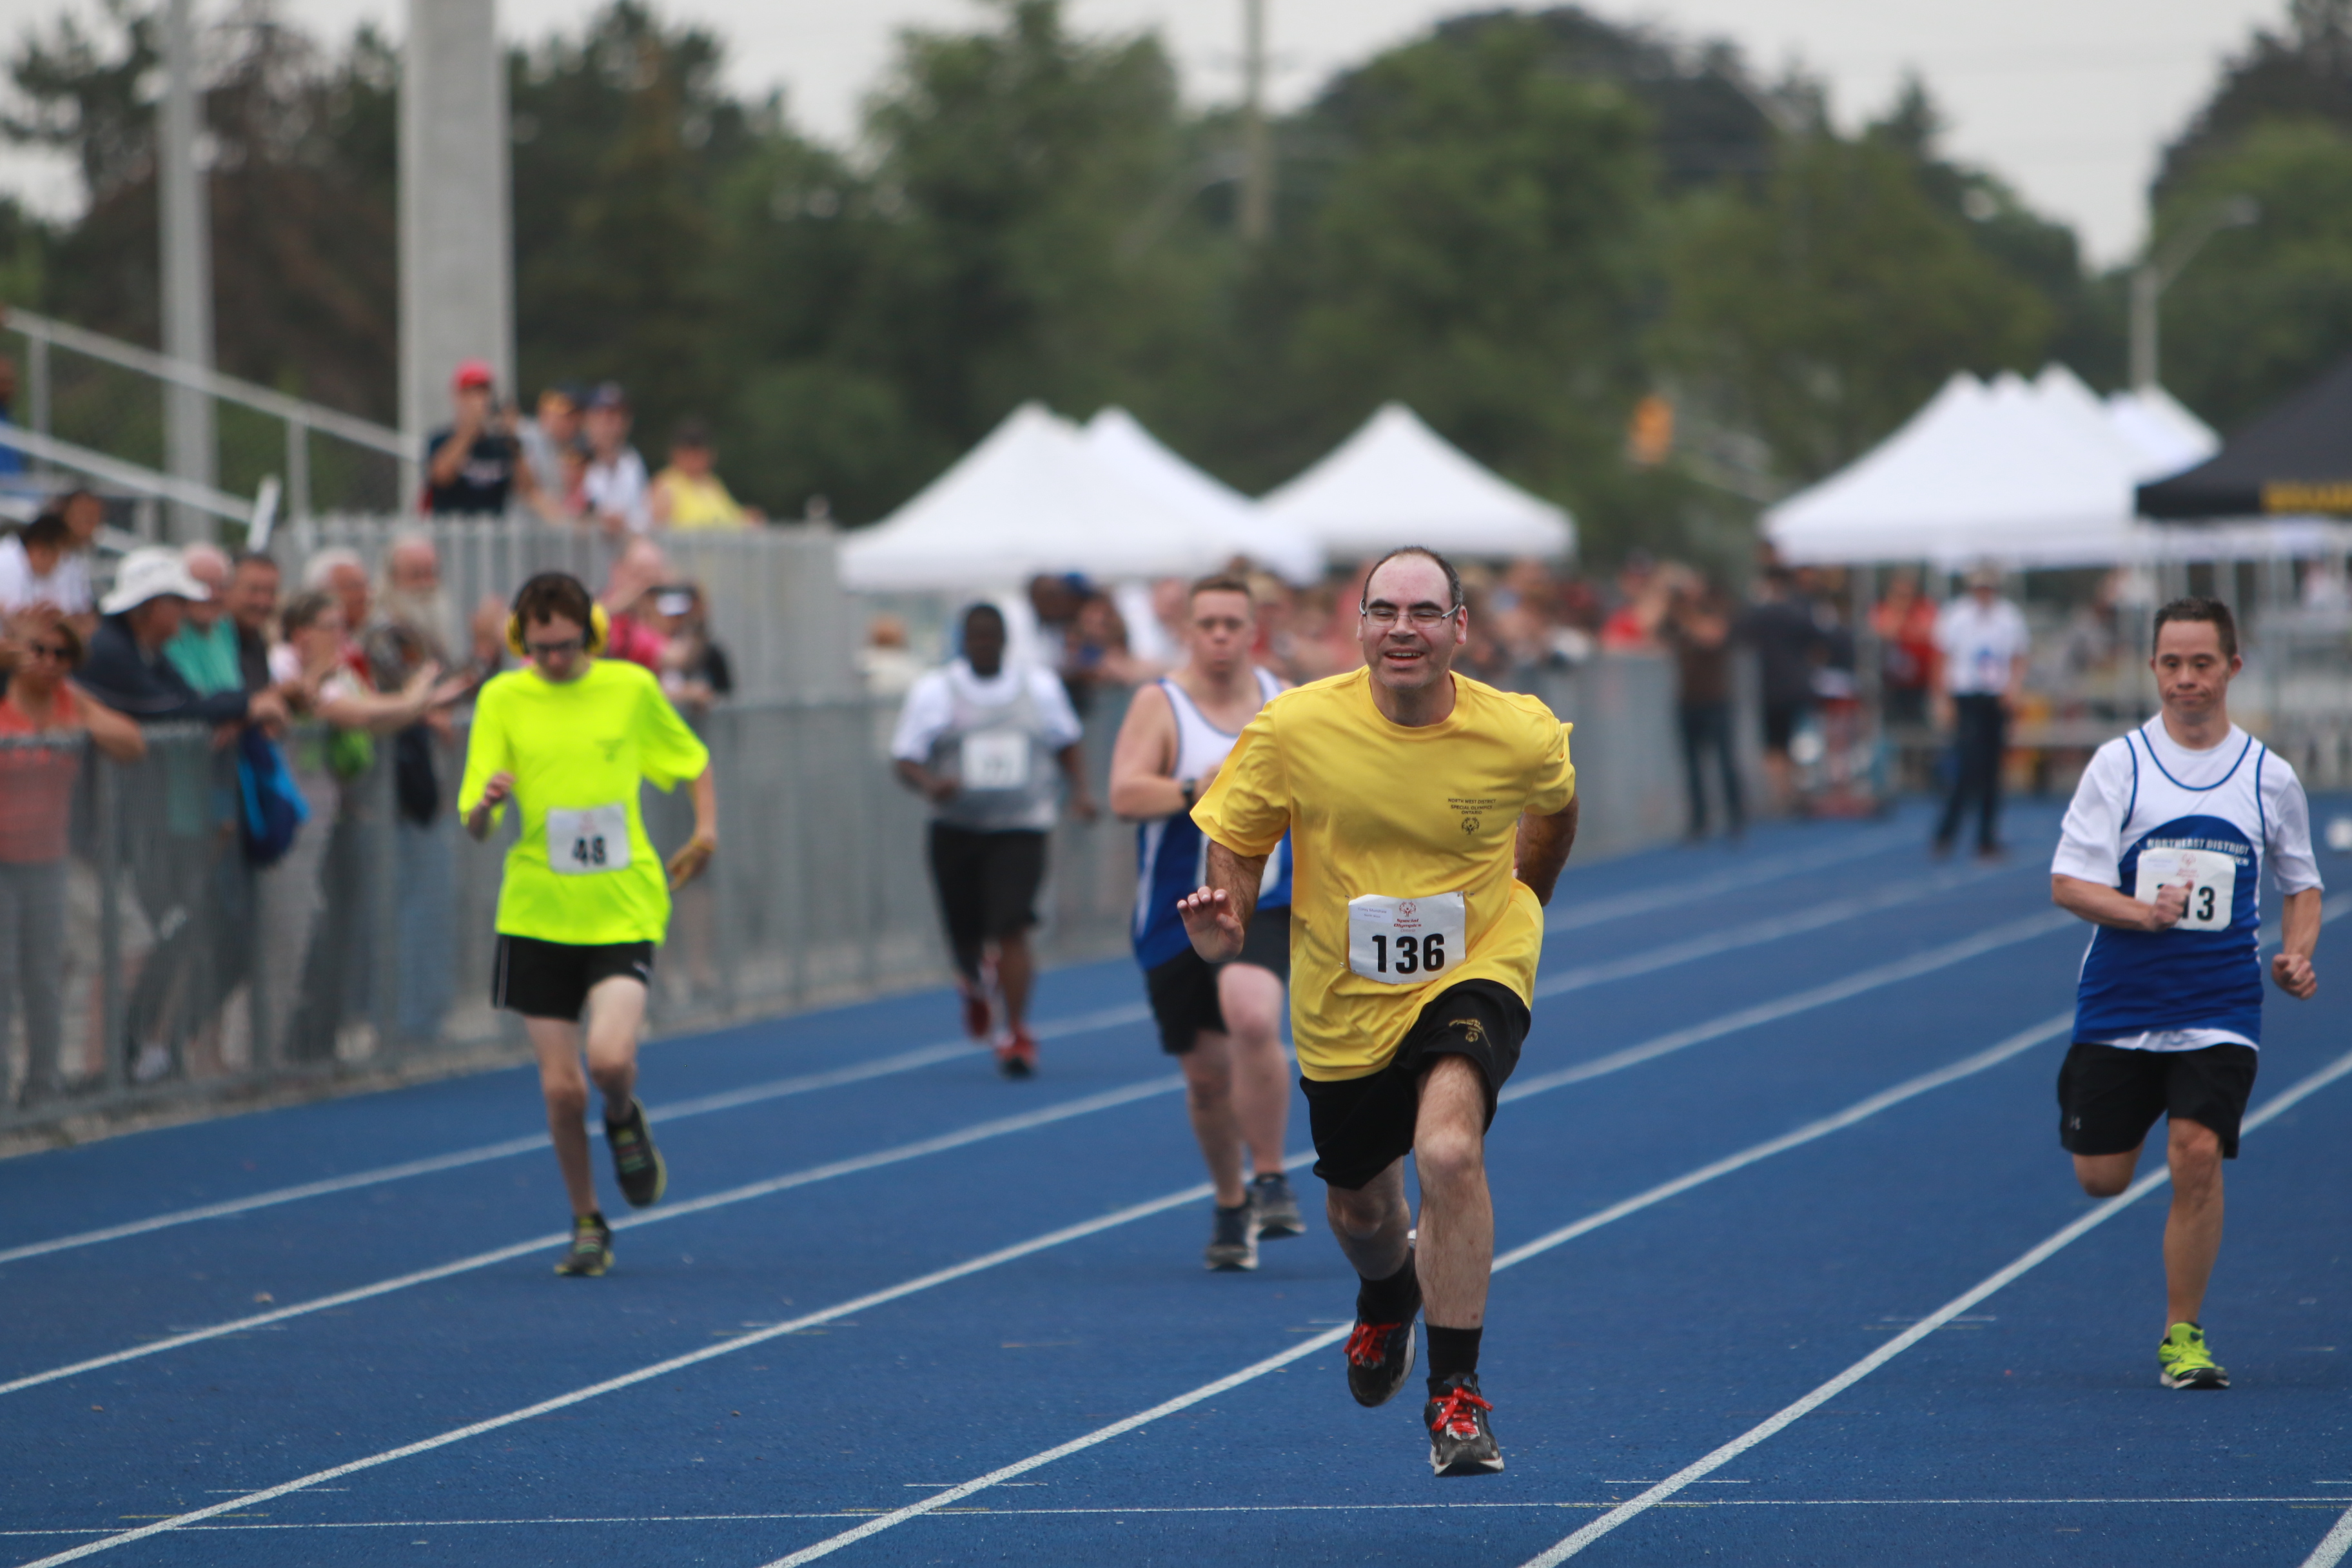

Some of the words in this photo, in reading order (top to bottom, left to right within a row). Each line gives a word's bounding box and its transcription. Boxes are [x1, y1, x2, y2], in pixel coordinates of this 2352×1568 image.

[573, 836, 606, 866] 48
[2206, 839, 2249, 855] DISTRICT
[1372, 933, 1445, 974] 136
